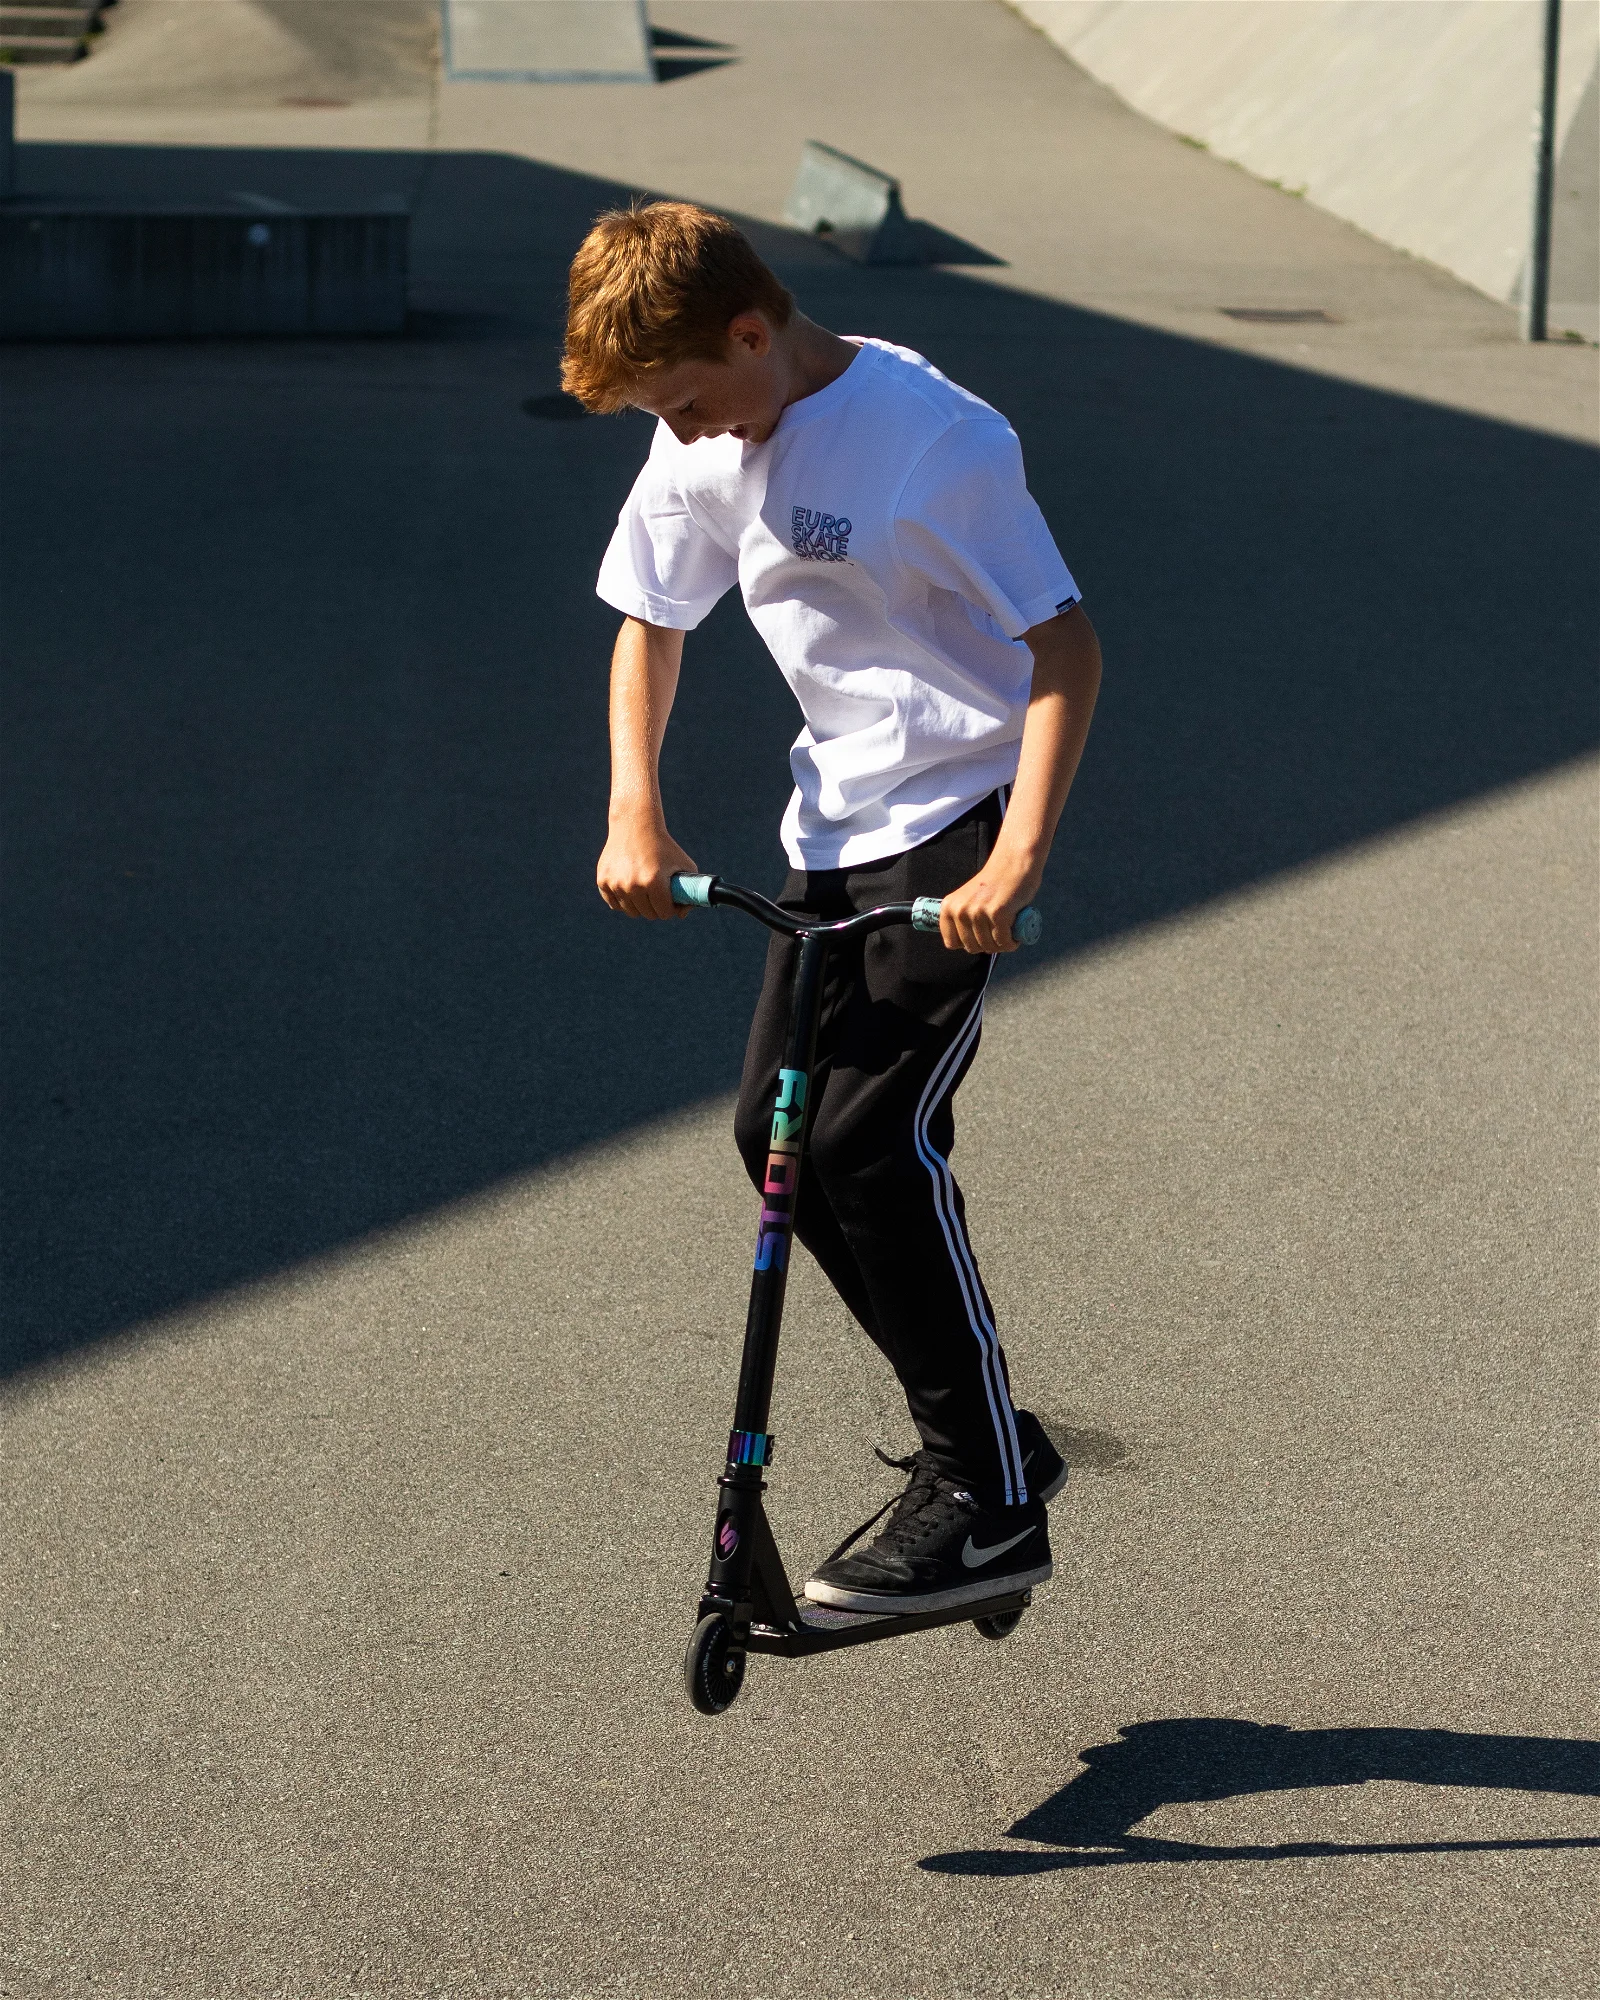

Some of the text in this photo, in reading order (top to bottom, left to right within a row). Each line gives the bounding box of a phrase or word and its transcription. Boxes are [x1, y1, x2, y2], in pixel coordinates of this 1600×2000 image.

[791, 505, 852, 537] EURO
[791, 524, 849, 556] SKATE
[754, 1068, 808, 1272] STORY
